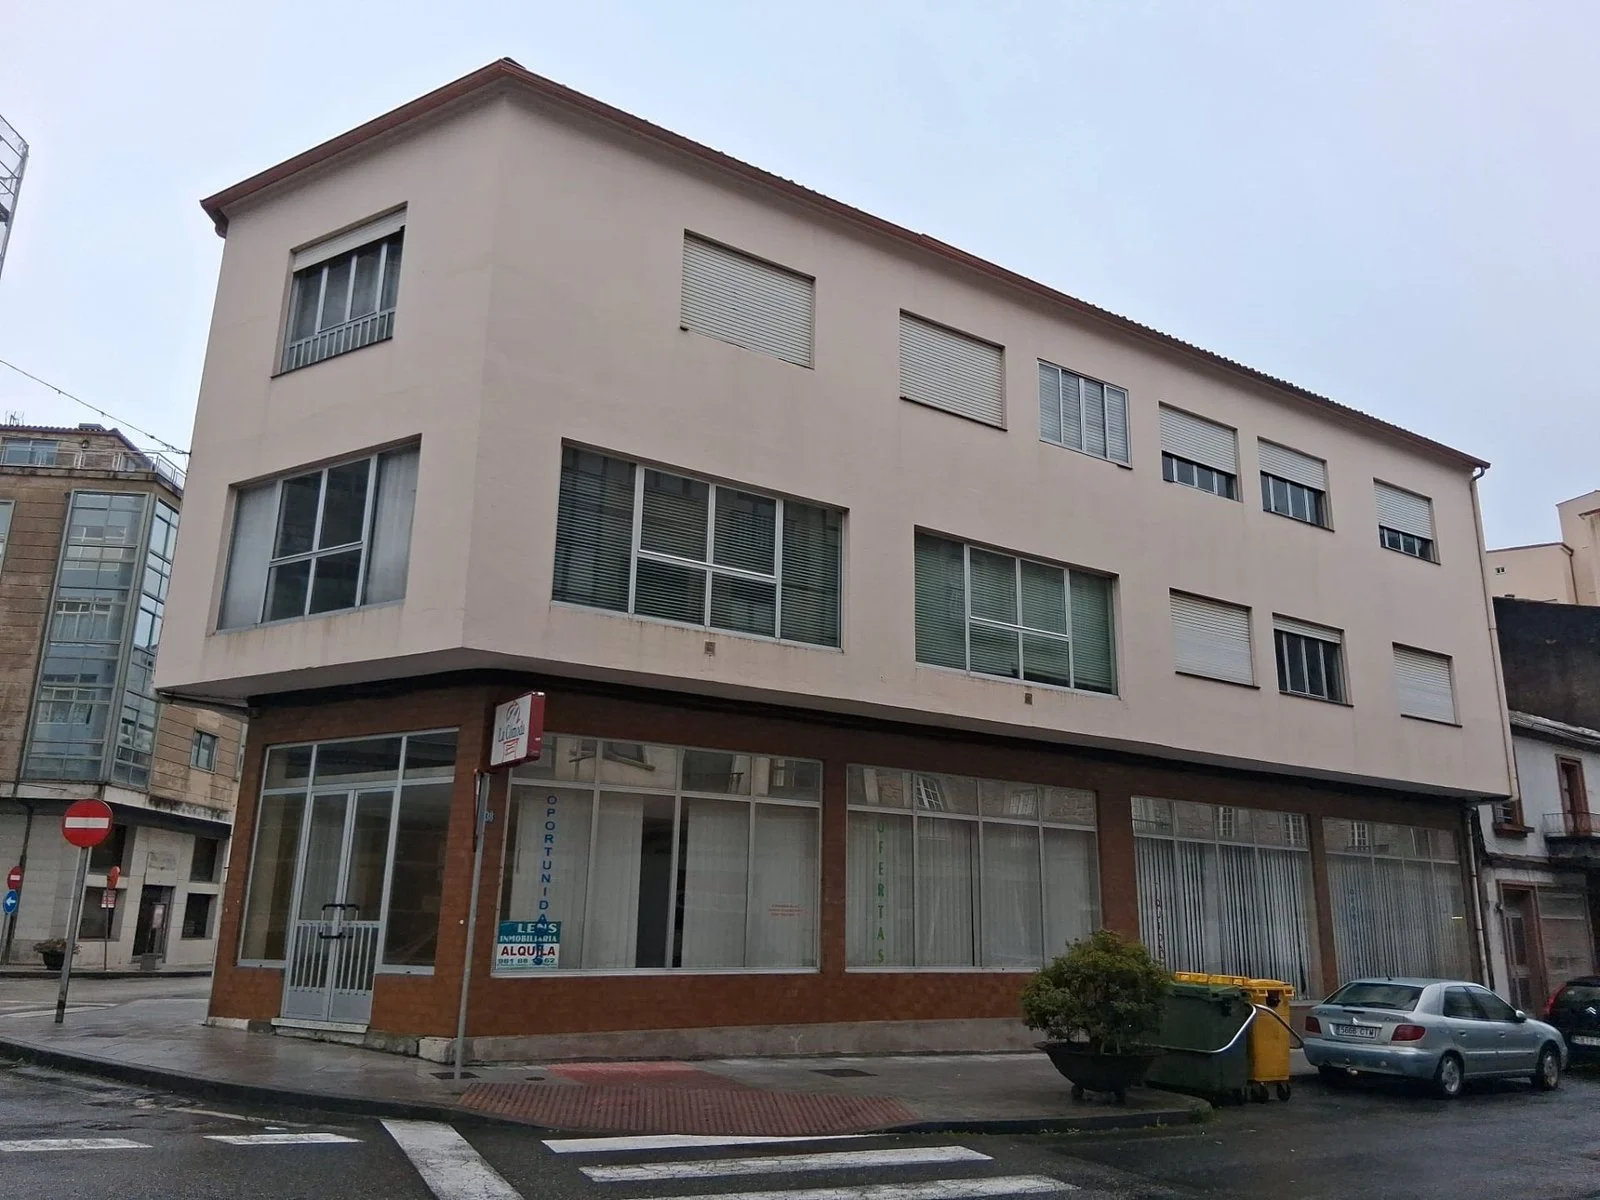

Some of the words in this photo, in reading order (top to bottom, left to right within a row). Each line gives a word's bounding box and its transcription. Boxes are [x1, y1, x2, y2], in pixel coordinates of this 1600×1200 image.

[532, 794, 558, 966] OPORTUNIDAS
[876, 821, 886, 964] OFERTAS
[501, 946, 556, 956] ALQUILA
[517, 923, 557, 933] LENS
